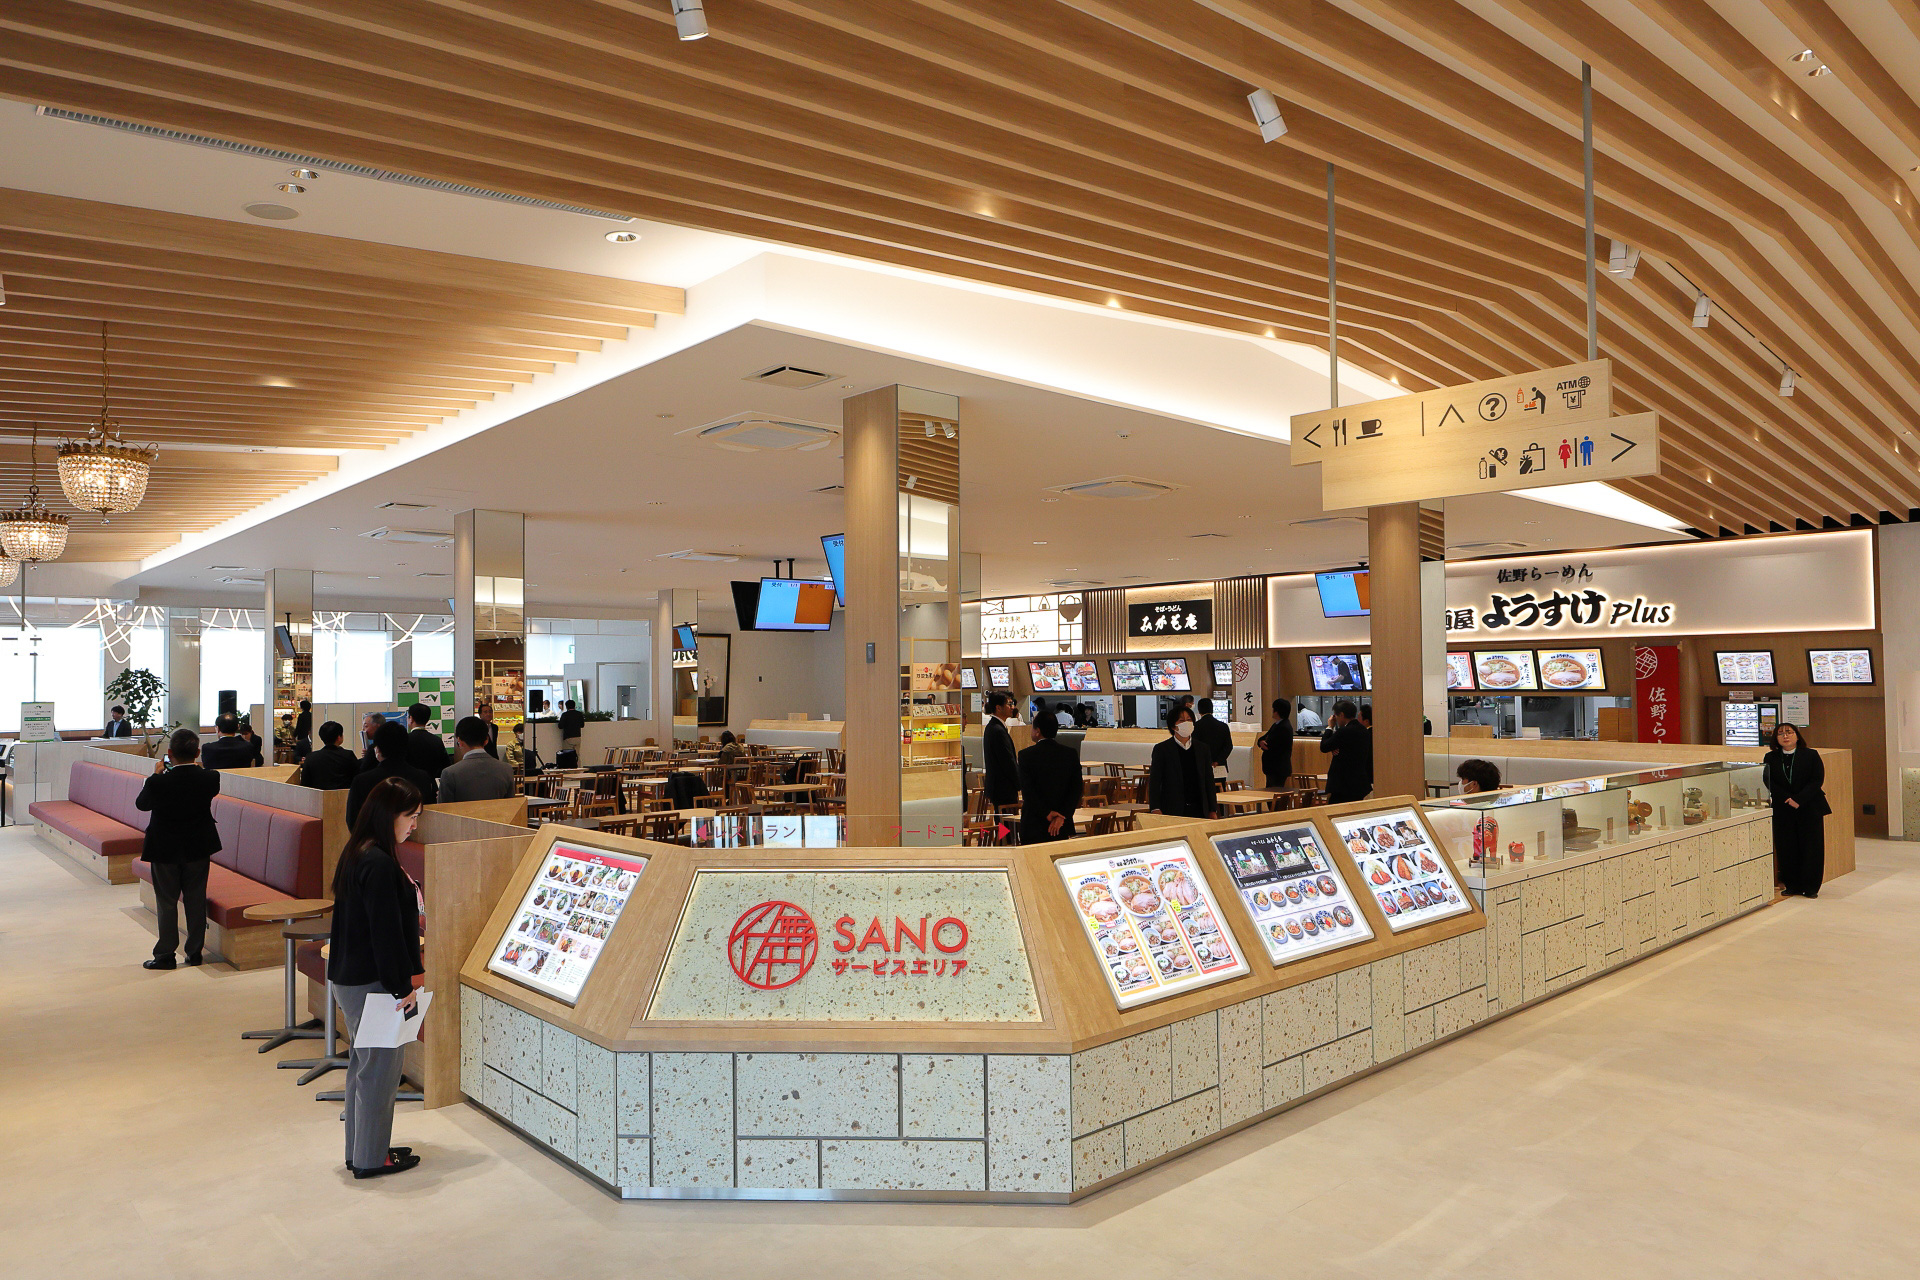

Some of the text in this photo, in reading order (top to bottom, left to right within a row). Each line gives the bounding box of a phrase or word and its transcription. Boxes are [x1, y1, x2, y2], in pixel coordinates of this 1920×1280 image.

[1556, 380, 1577, 391] ATM
[1497, 563, 1593, 583] 佐野らーめん
[1155, 605, 1182, 613] そば・うどん
[1482, 590, 1607, 628] ようすけ
[1610, 598, 1671, 625] Plus
[981, 624, 1039, 641] くろはかま亭
[1244, 692, 1255, 716] そば
[1649, 687, 1667, 744] 佐野ら
[715, 825, 796, 839] レストラン
[890, 825, 990, 839] フードコート
[833, 916, 969, 953] SANO
[831, 958, 968, 977] サービスエリア
